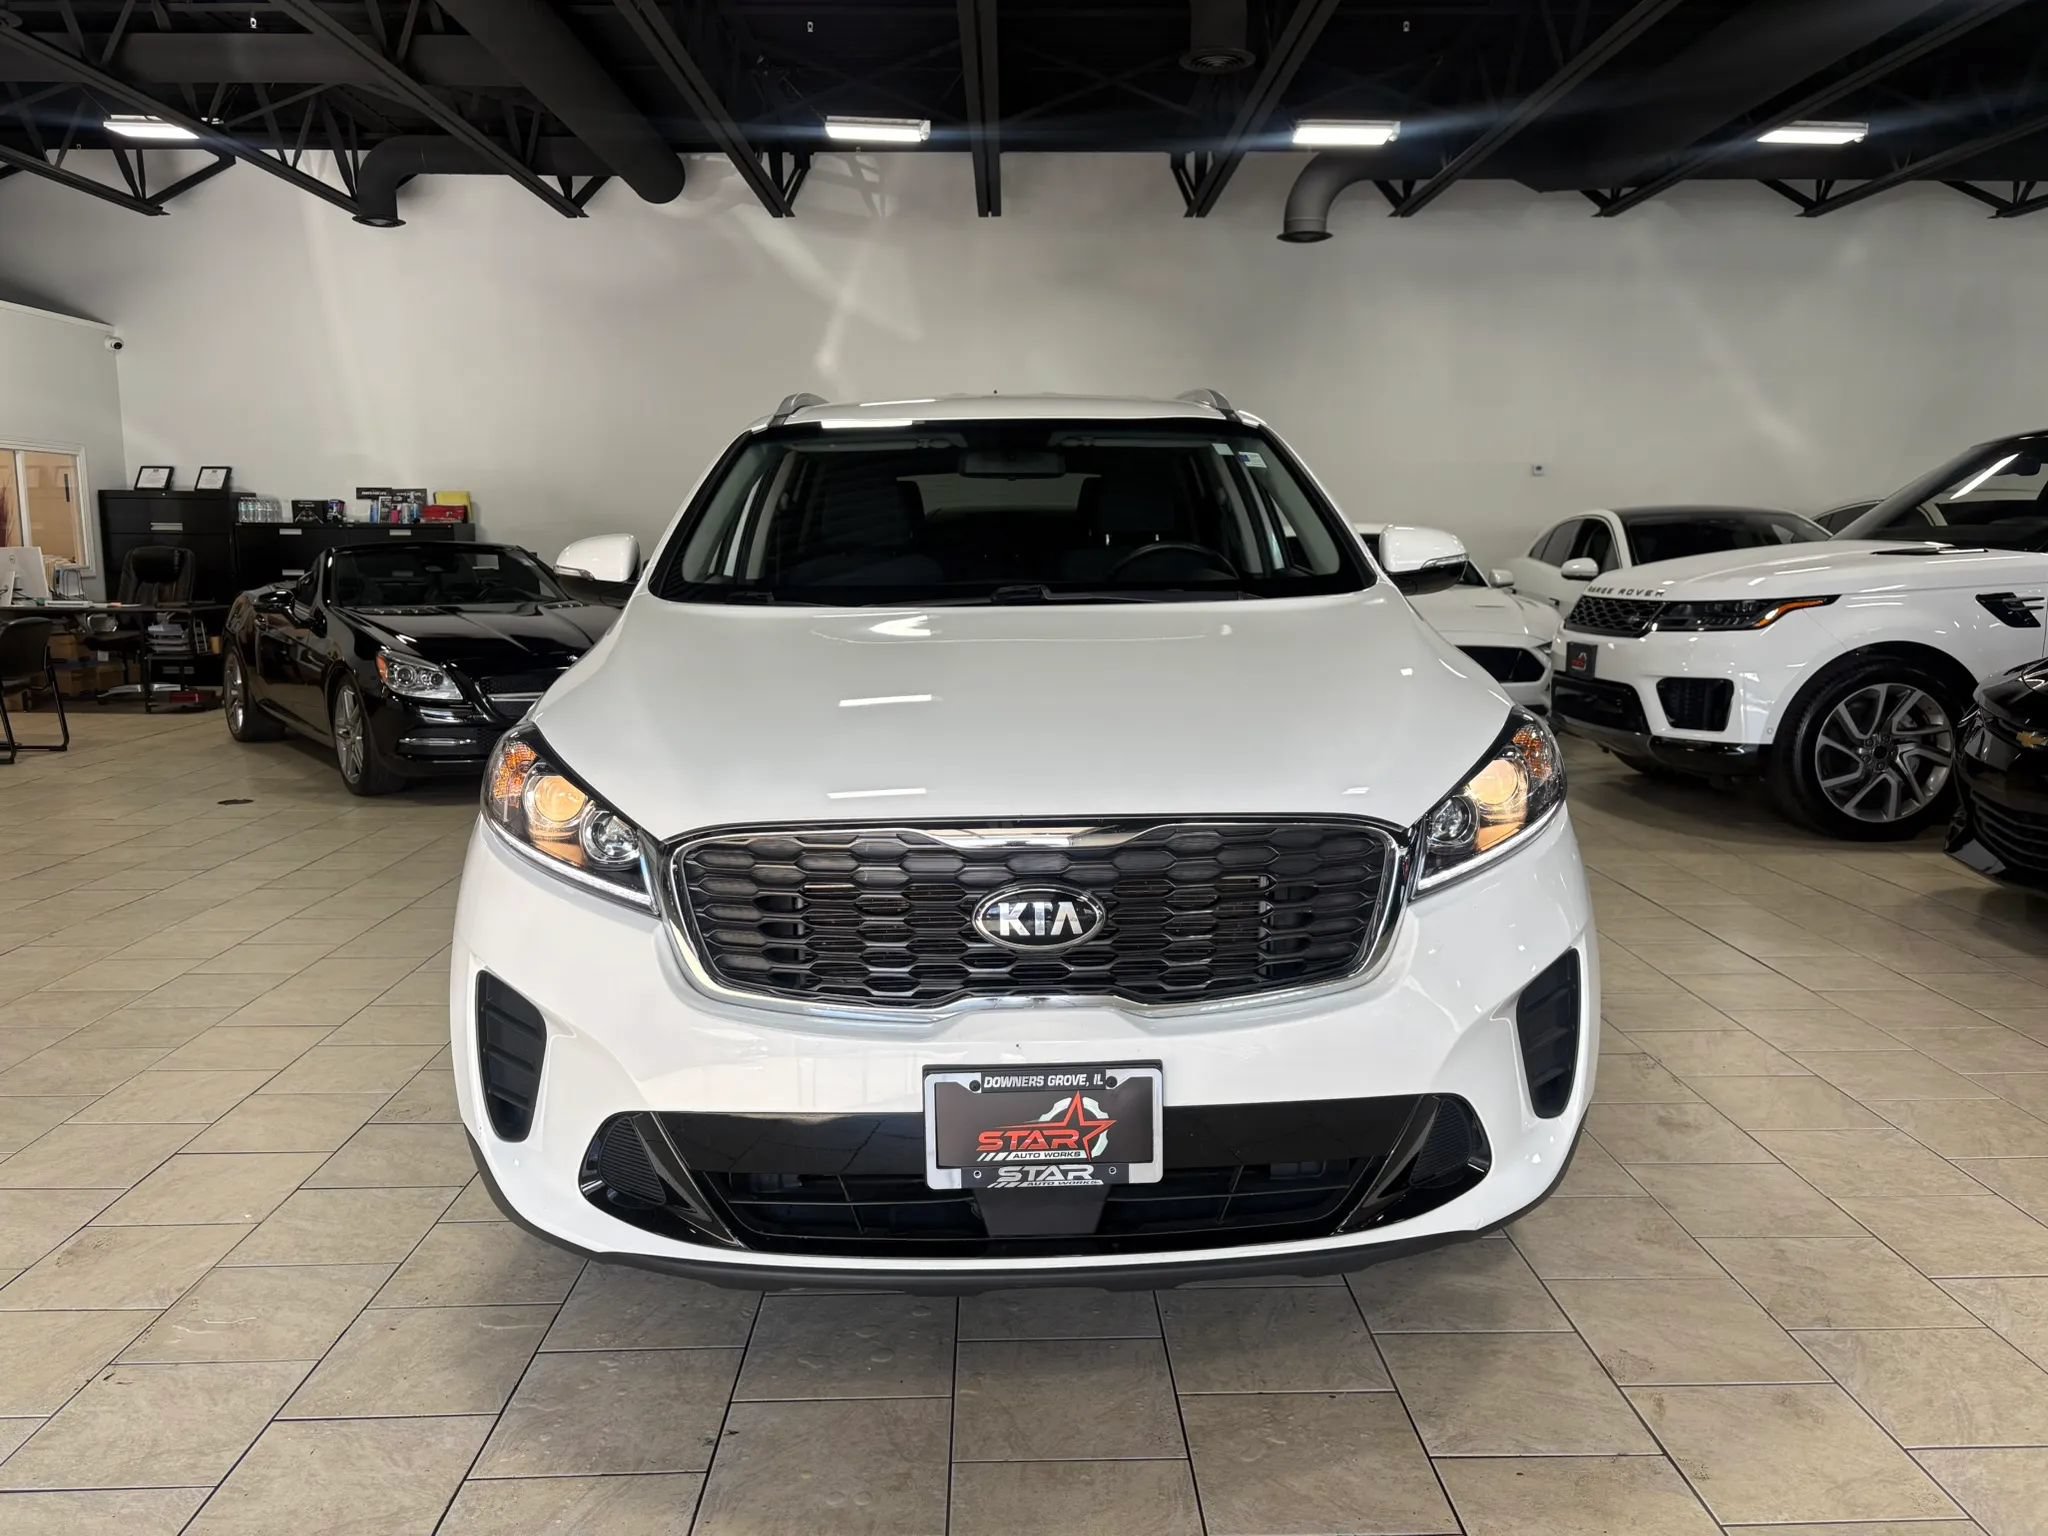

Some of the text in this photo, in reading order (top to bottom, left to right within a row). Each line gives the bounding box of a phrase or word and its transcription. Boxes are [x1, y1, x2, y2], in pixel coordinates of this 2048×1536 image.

[983, 1073, 1104, 1088] DOWNERS GROVE, IL
[976, 1129, 1080, 1151] STAR
[996, 1164, 1095, 1183] STAR
